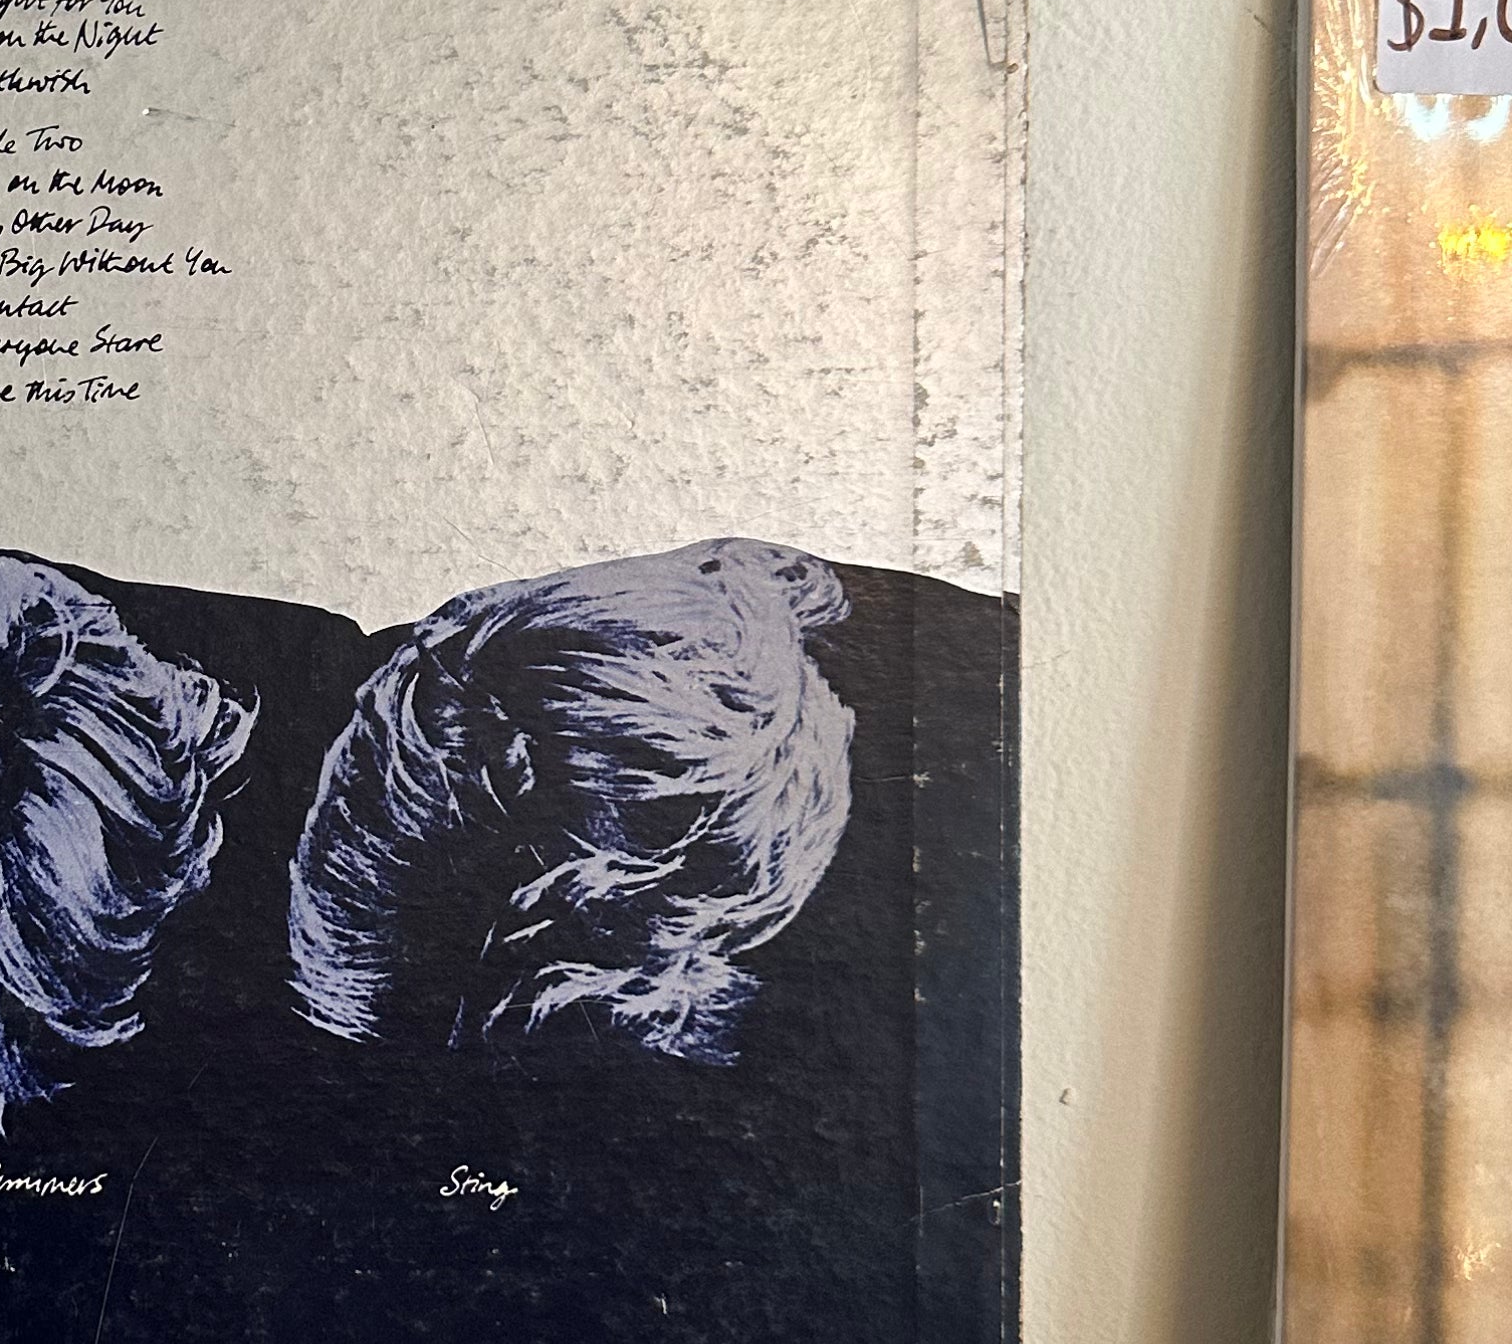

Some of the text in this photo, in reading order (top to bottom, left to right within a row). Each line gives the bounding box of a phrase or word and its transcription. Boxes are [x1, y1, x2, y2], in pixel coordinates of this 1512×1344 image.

[32, 20, 69, 48] the
[73, 20, 164, 59] Night
[26, 124, 84, 153] Two
[7, 174, 40, 195] on
[49, 168, 85, 196] the
[90, 168, 164, 198] Moon
[11, 208, 83, 235] Other
[86, 206, 154, 244] Day
[57, 247, 175, 277] Without
[186, 246, 233, 276] You
[89, 323, 164, 355] Stare
[25, 376, 76, 404] this
[77, 375, 141, 403] Time
[439, 1164, 519, 1211] Sting
